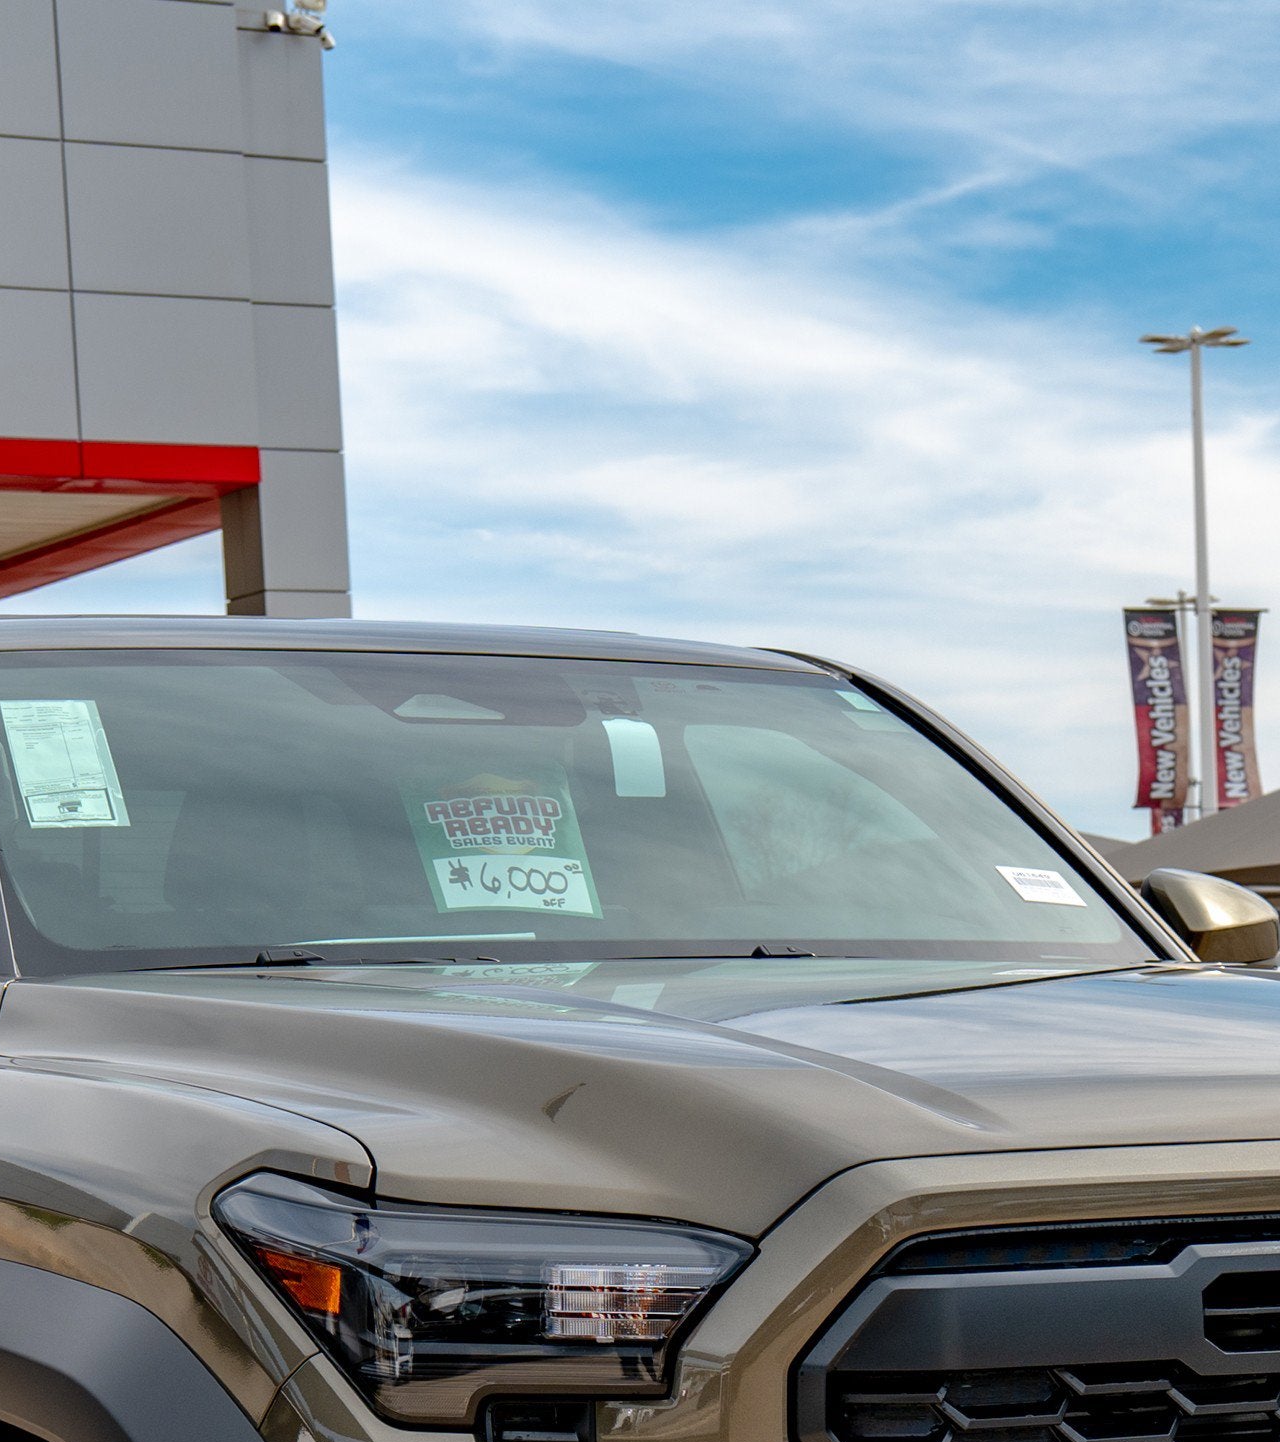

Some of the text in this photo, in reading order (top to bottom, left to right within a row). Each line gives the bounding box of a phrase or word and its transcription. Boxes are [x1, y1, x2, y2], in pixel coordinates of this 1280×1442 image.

[1146, 656, 1176, 747] Vehicles
[1218, 656, 1242, 748] Vehicles
[1150, 750, 1176, 799] New
[1224, 751, 1250, 798] New
[425, 796, 561, 823] REFUND
[444, 816, 555, 838] READY
[452, 836, 554, 848] SALES EVENT
